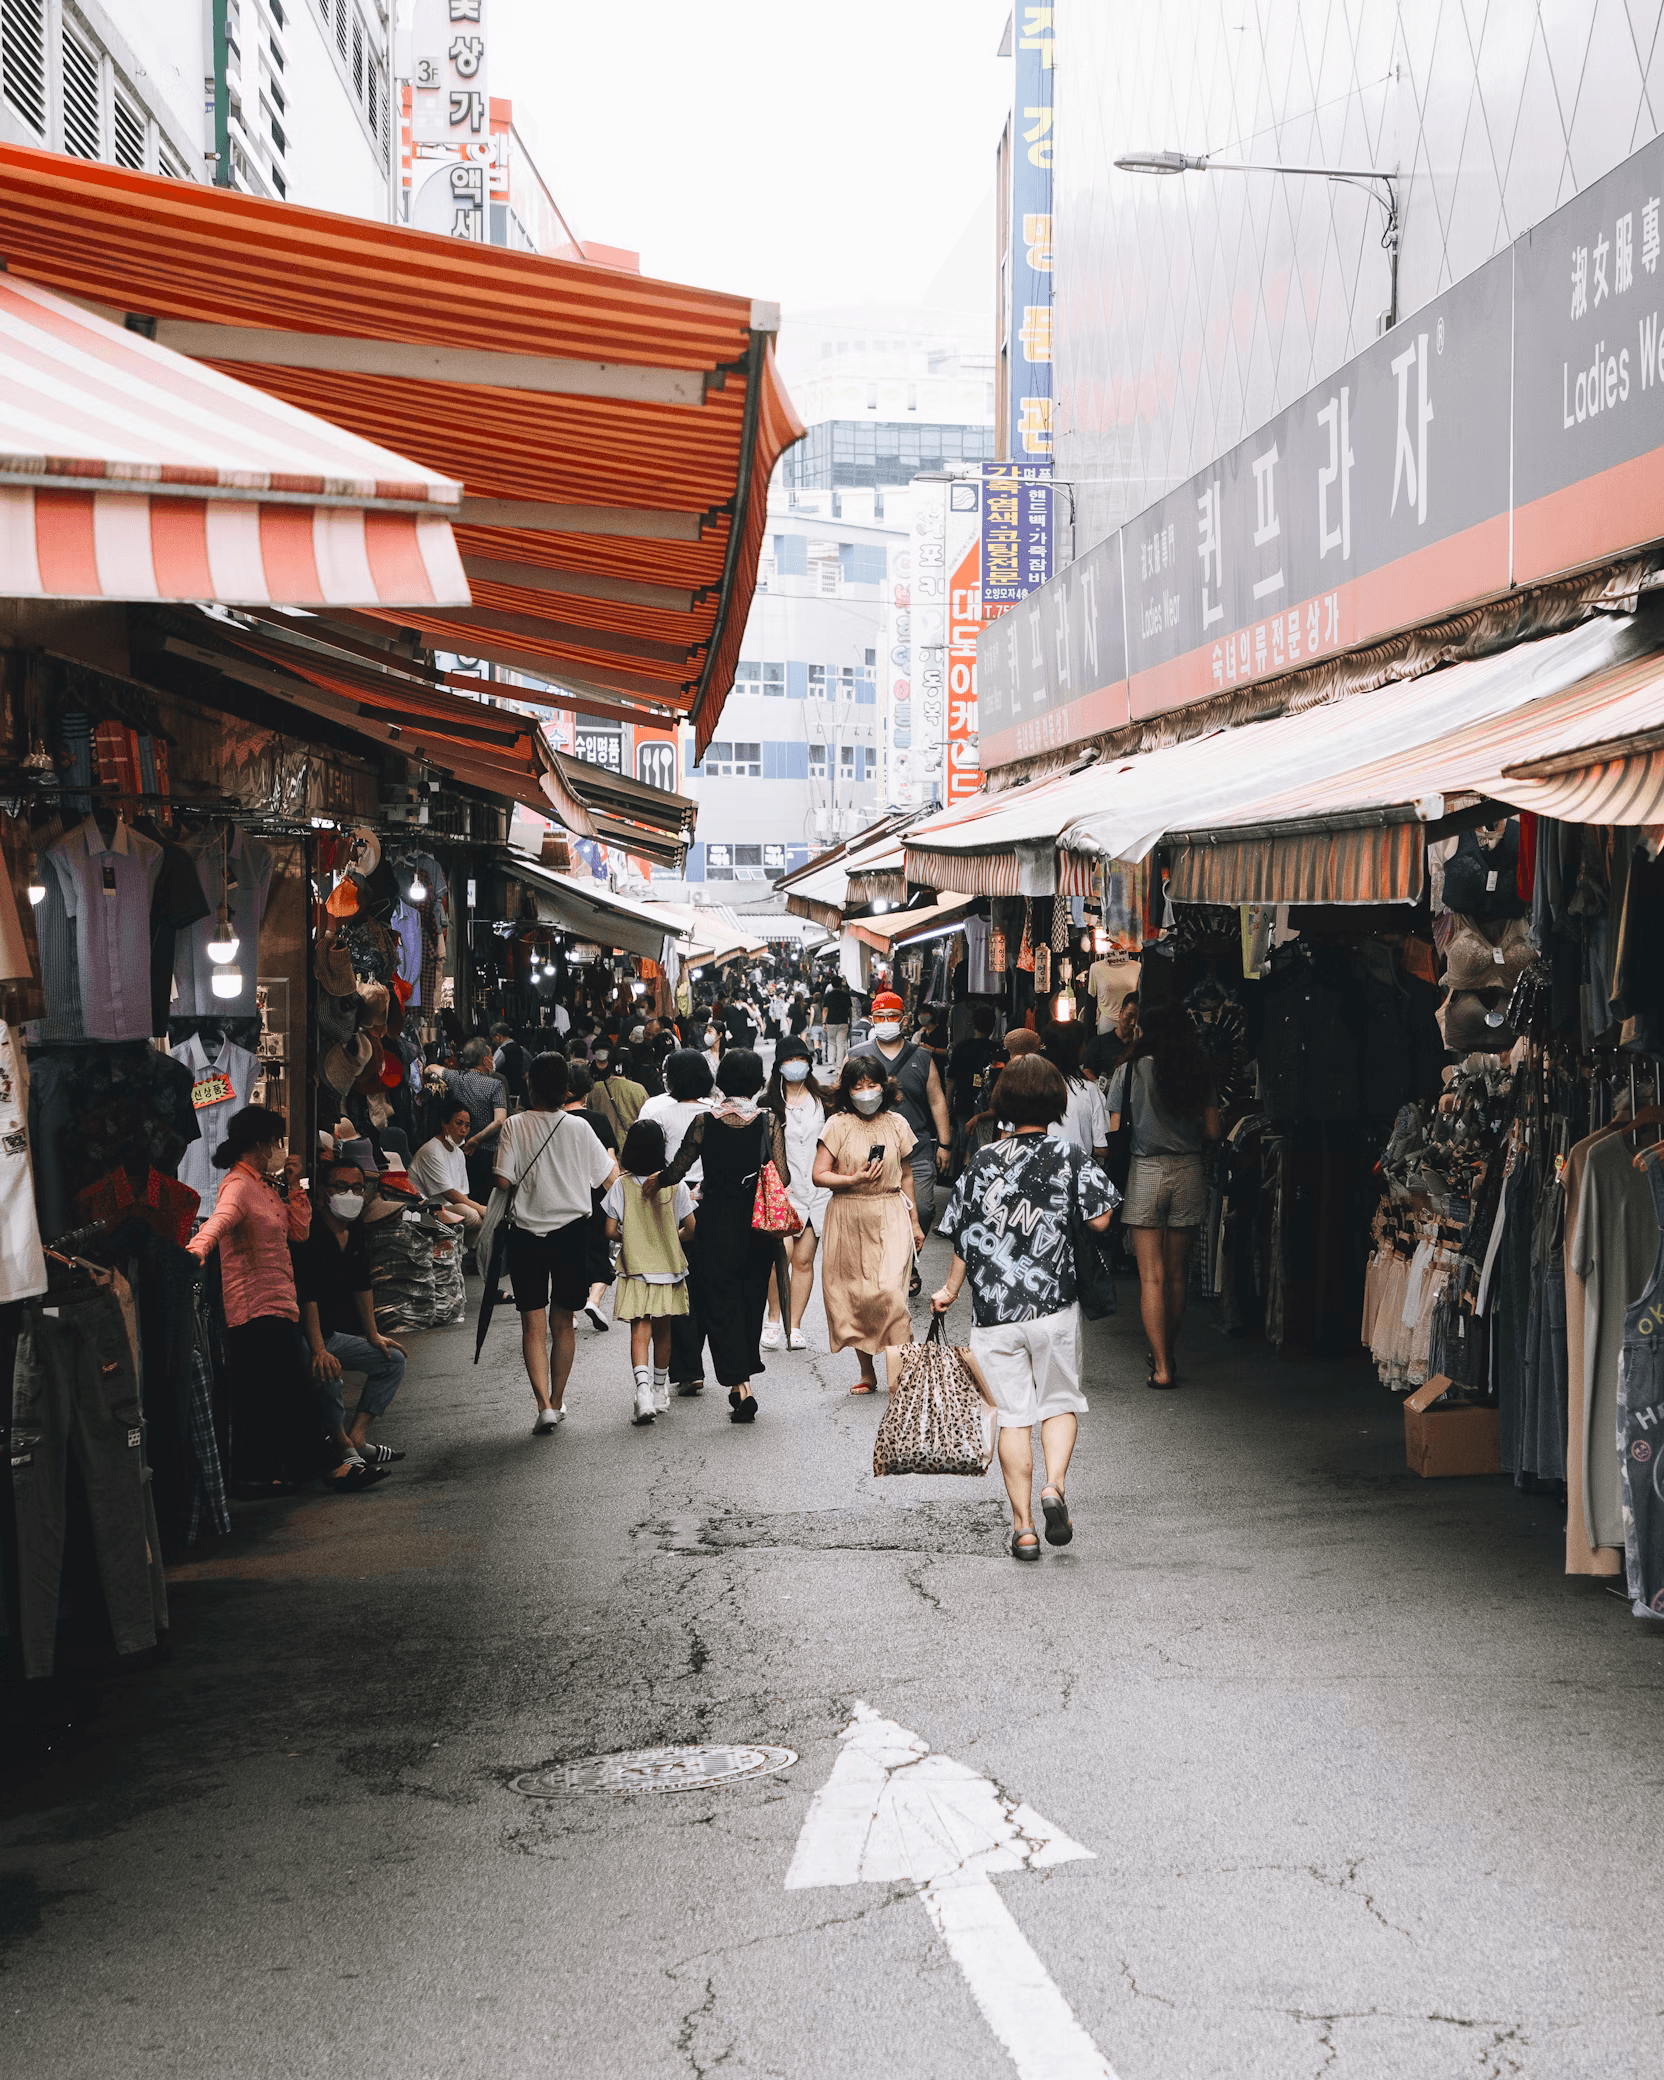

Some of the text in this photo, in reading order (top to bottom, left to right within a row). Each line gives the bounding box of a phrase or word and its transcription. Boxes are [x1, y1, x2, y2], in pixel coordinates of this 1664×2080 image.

[417, 60, 439, 82] 3F
[1563, 340, 1630, 430] Ladies
[1196, 332, 1435, 631] 퀸프라자
[1141, 588, 1180, 640] Ladies Wear
[1007, 564, 1099, 717] 퀸프라자
[575, 735, 620, 764] 수입명품
[194, 1083, 222, 1101] 신상품
